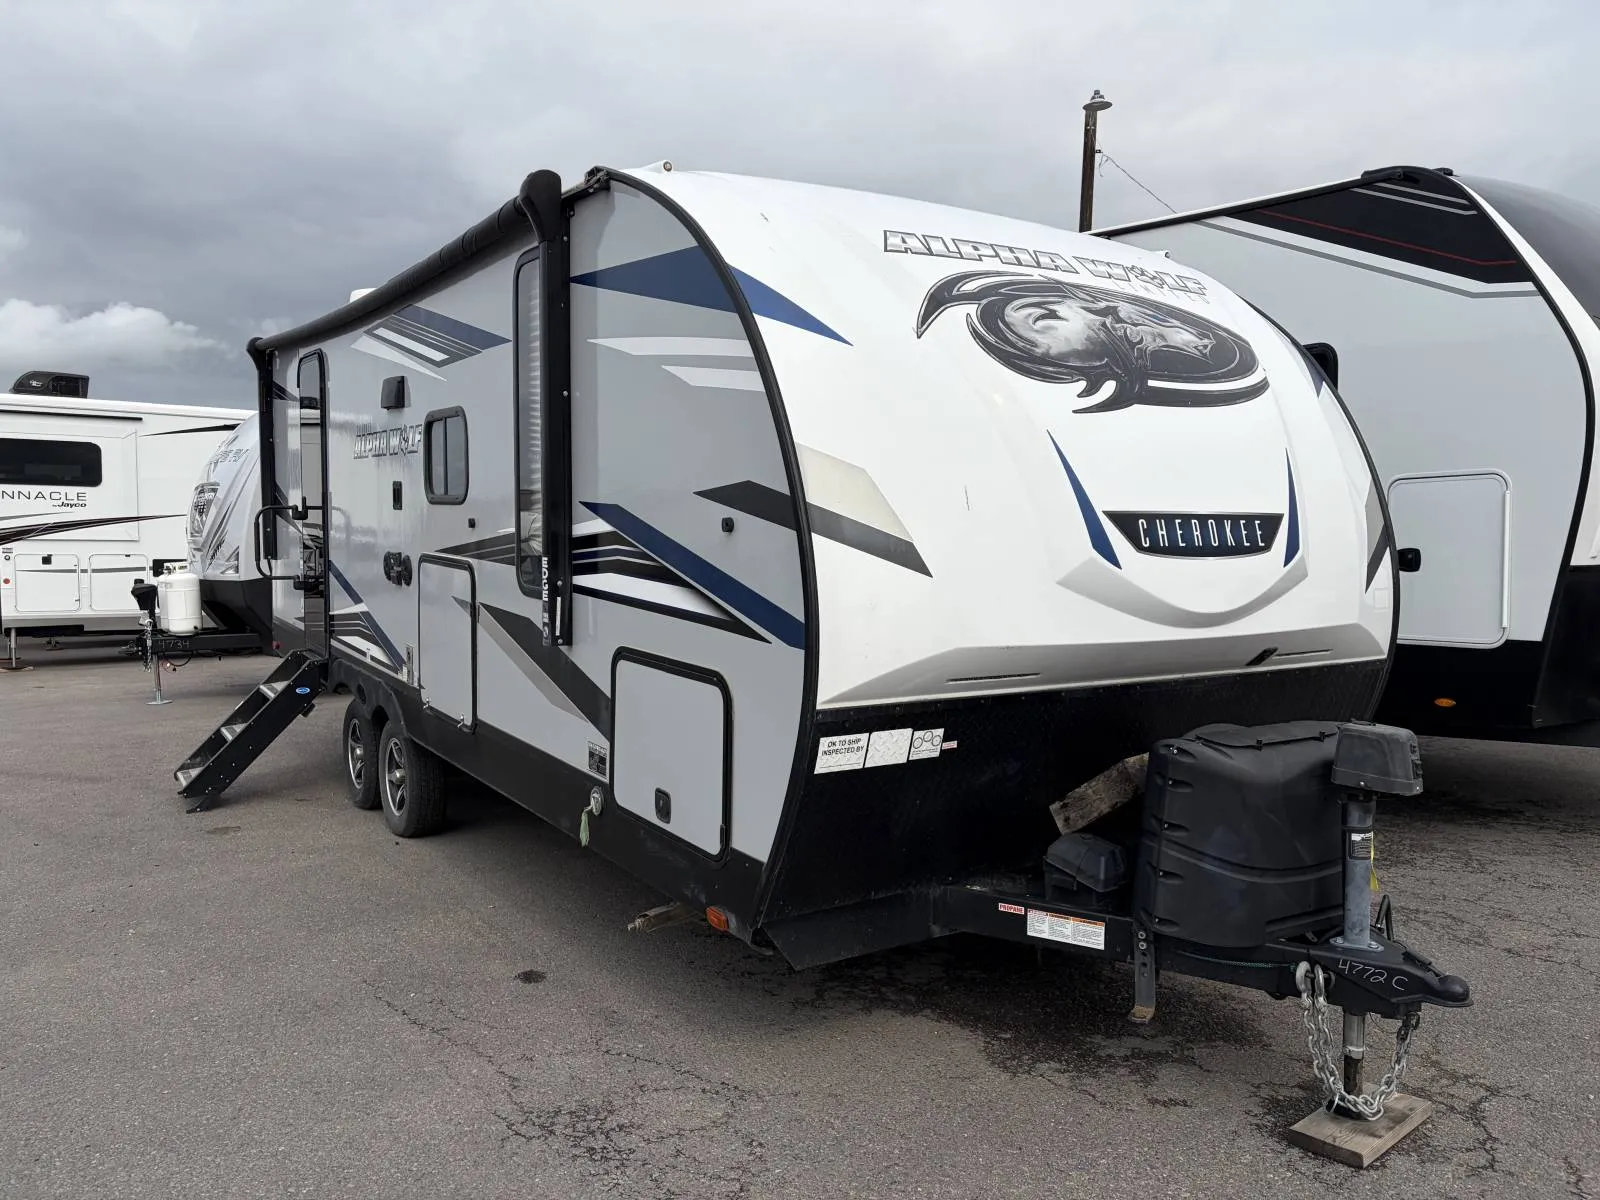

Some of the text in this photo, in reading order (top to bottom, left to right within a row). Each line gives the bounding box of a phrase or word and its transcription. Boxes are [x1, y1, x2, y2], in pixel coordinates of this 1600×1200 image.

[884, 230, 1079, 274] ALPHA
[354, 430, 388, 459] ALPHA
[58, 501, 87, 509] Jayco
[1138, 518, 1265, 547] CHEROKEE
[158, 639, 191, 649] 4734
[838, 739, 847, 747] TO
[847, 737, 862, 746] SHIP
[821, 746, 855, 757] INSPECTED
[1000, 904, 1024, 914] PROPANE
[1338, 958, 1409, 991] 4772 C
